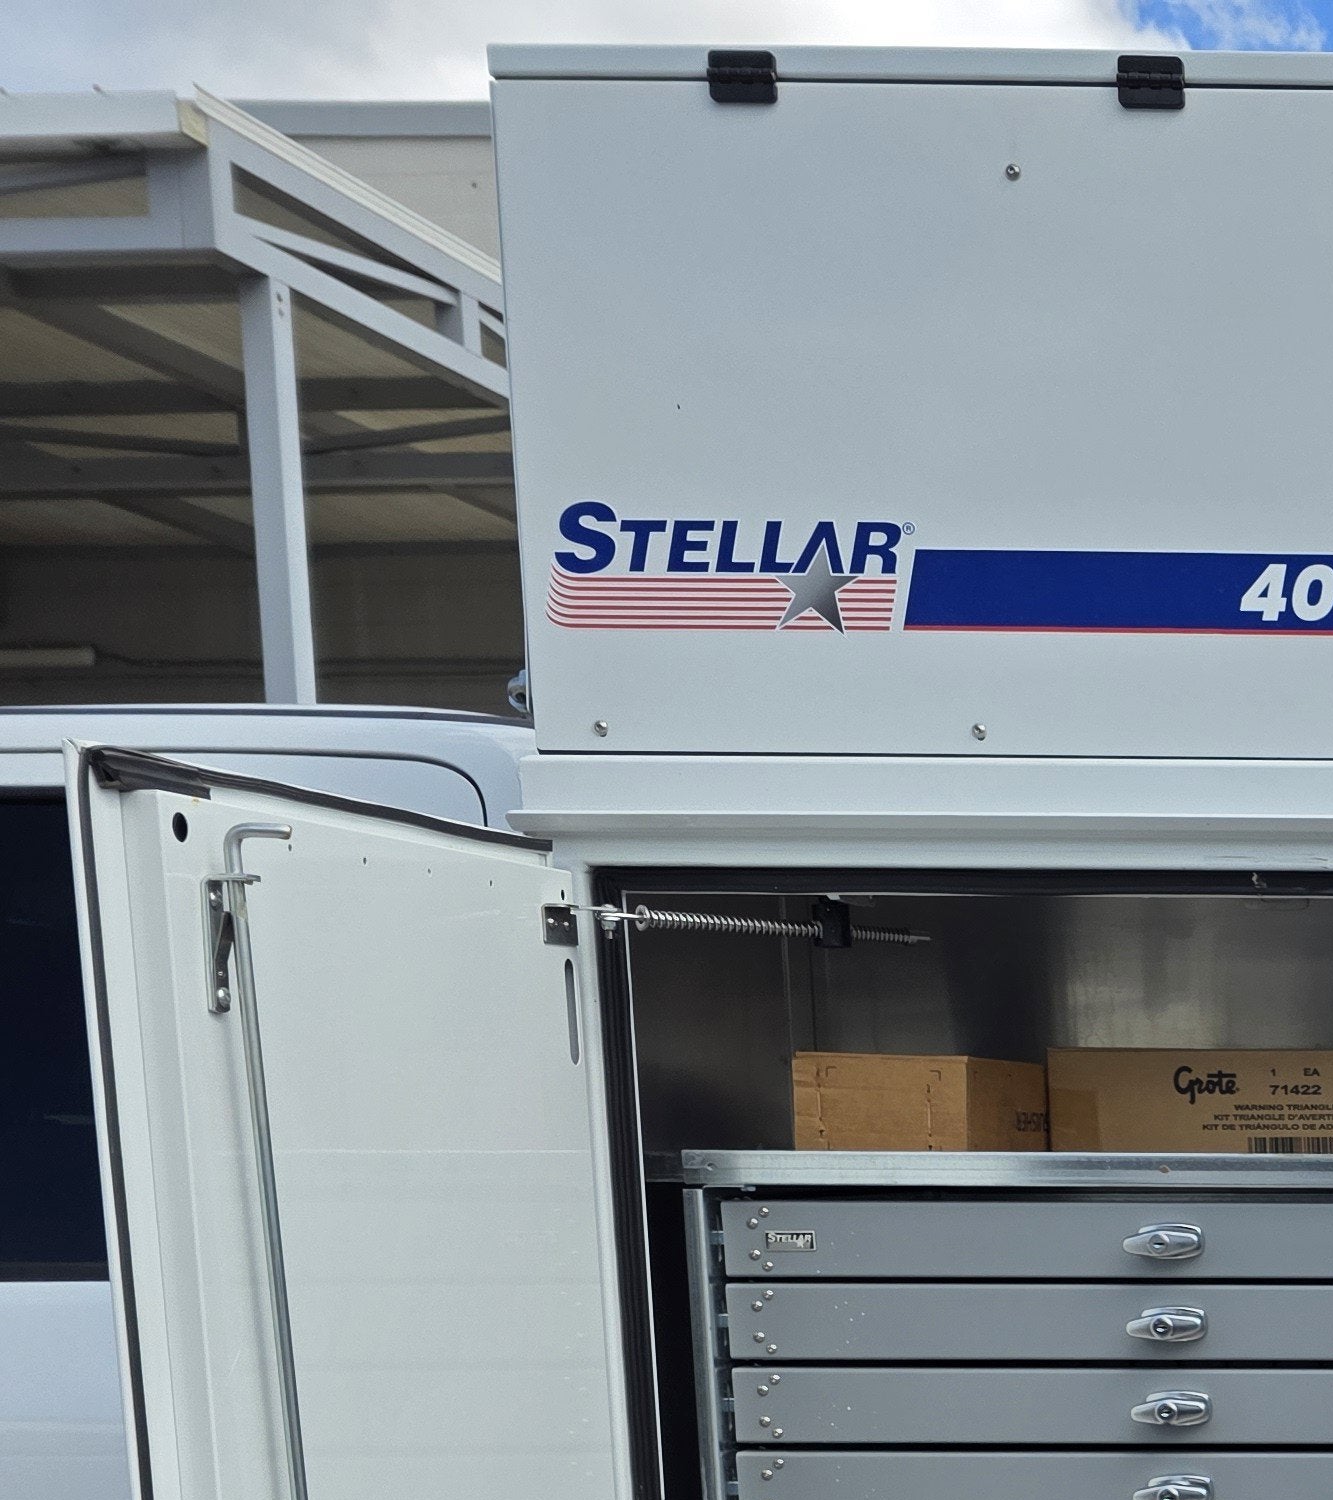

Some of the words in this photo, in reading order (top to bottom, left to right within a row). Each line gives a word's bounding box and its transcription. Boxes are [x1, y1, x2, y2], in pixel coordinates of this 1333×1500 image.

[555, 501, 901, 574] STELLAR
[1270, 1068, 1276, 1076] 1
[1303, 1068, 1320, 1076] EA
[1173, 1065, 1237, 1104] Grote
[1269, 1085, 1322, 1095] 71422
